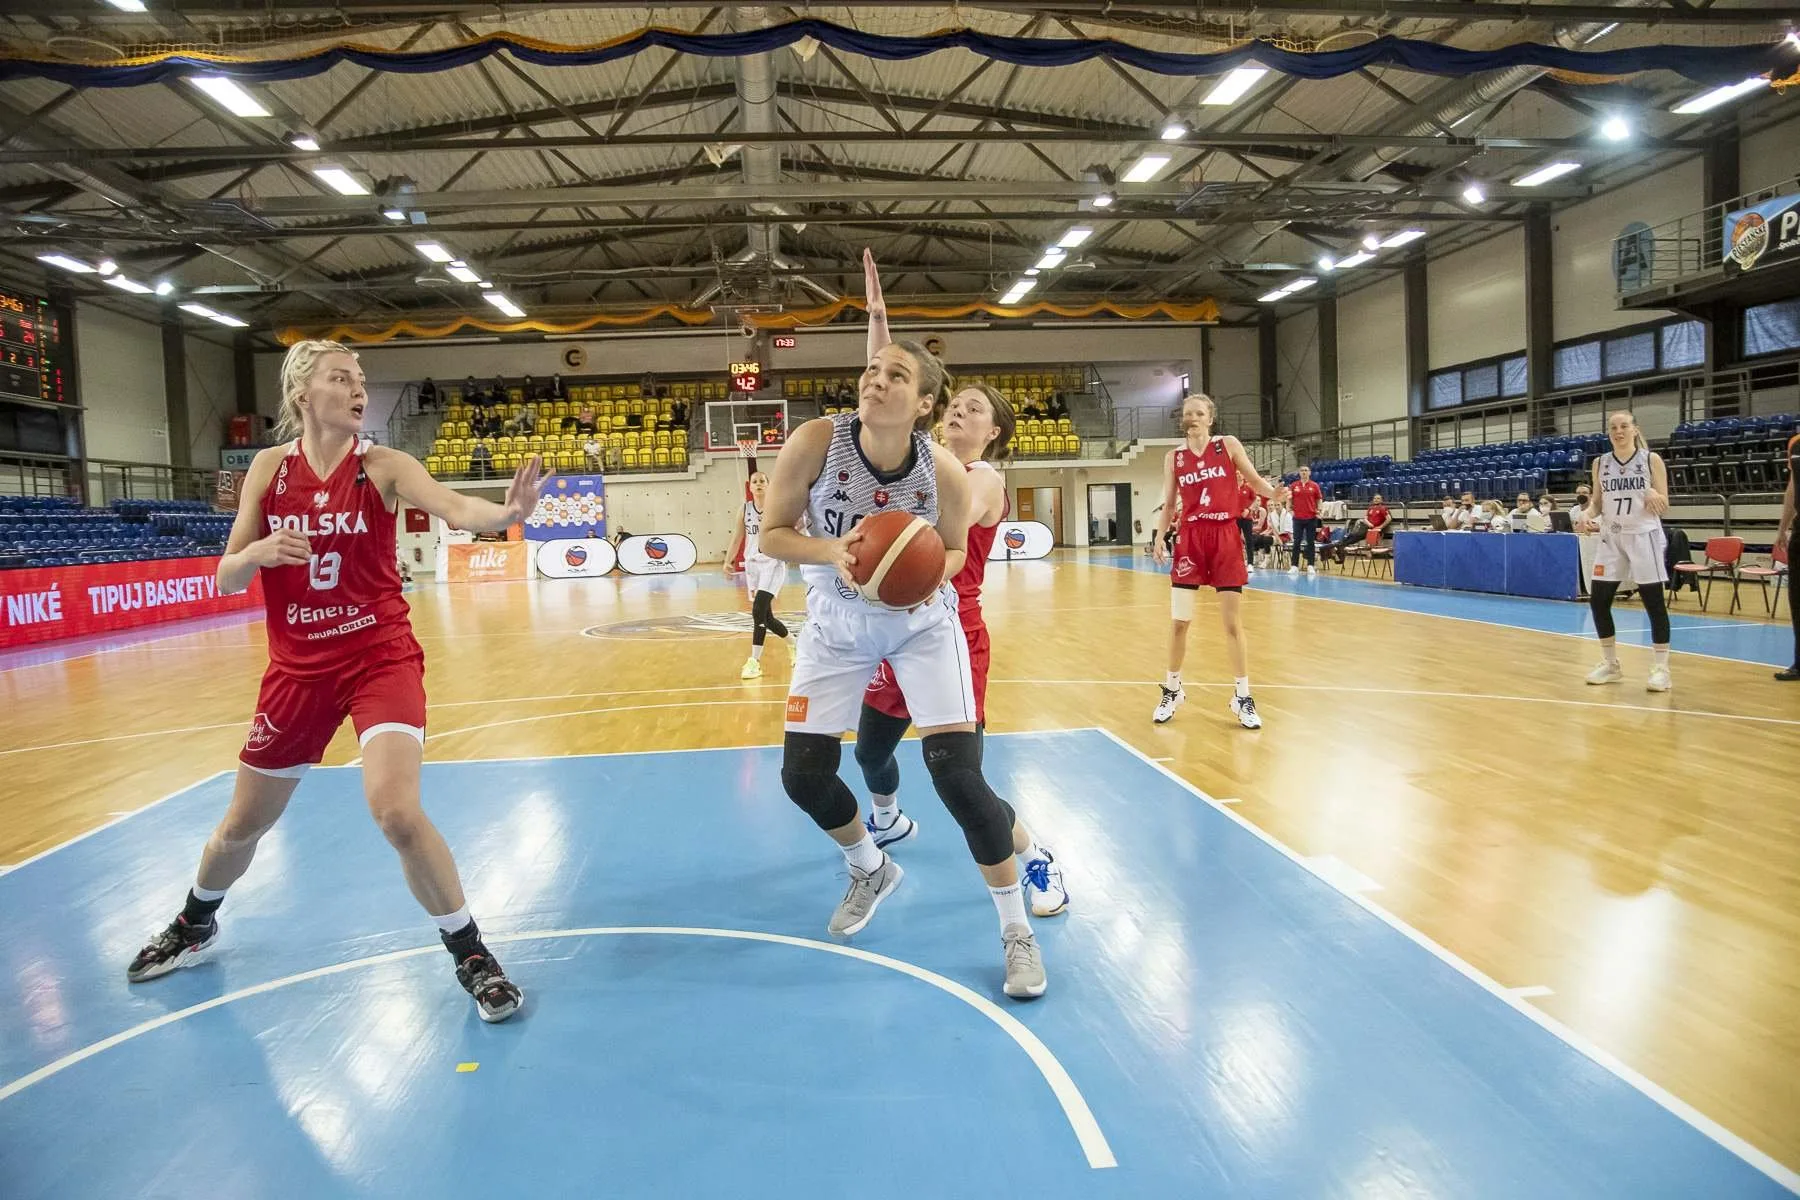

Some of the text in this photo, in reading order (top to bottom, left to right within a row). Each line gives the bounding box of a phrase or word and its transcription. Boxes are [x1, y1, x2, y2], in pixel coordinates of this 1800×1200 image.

[1781, 211, 1800, 240] P
[730, 362, 760, 375] 03:46
[736, 376, 756, 391] 4.2
[1179, 466, 1227, 487] POLSKA
[1602, 476, 1646, 493] SLOVAKIA
[1199, 487, 1211, 507] 4
[1613, 497, 1632, 516] 77
[267, 510, 368, 537] POLSKA
[309, 551, 342, 591] 13
[8, 583, 63, 627] NIKÉ
[88, 574, 216, 615] TIPUJ BASKET V
[307, 616, 375, 640] GRUPA ORLEN
